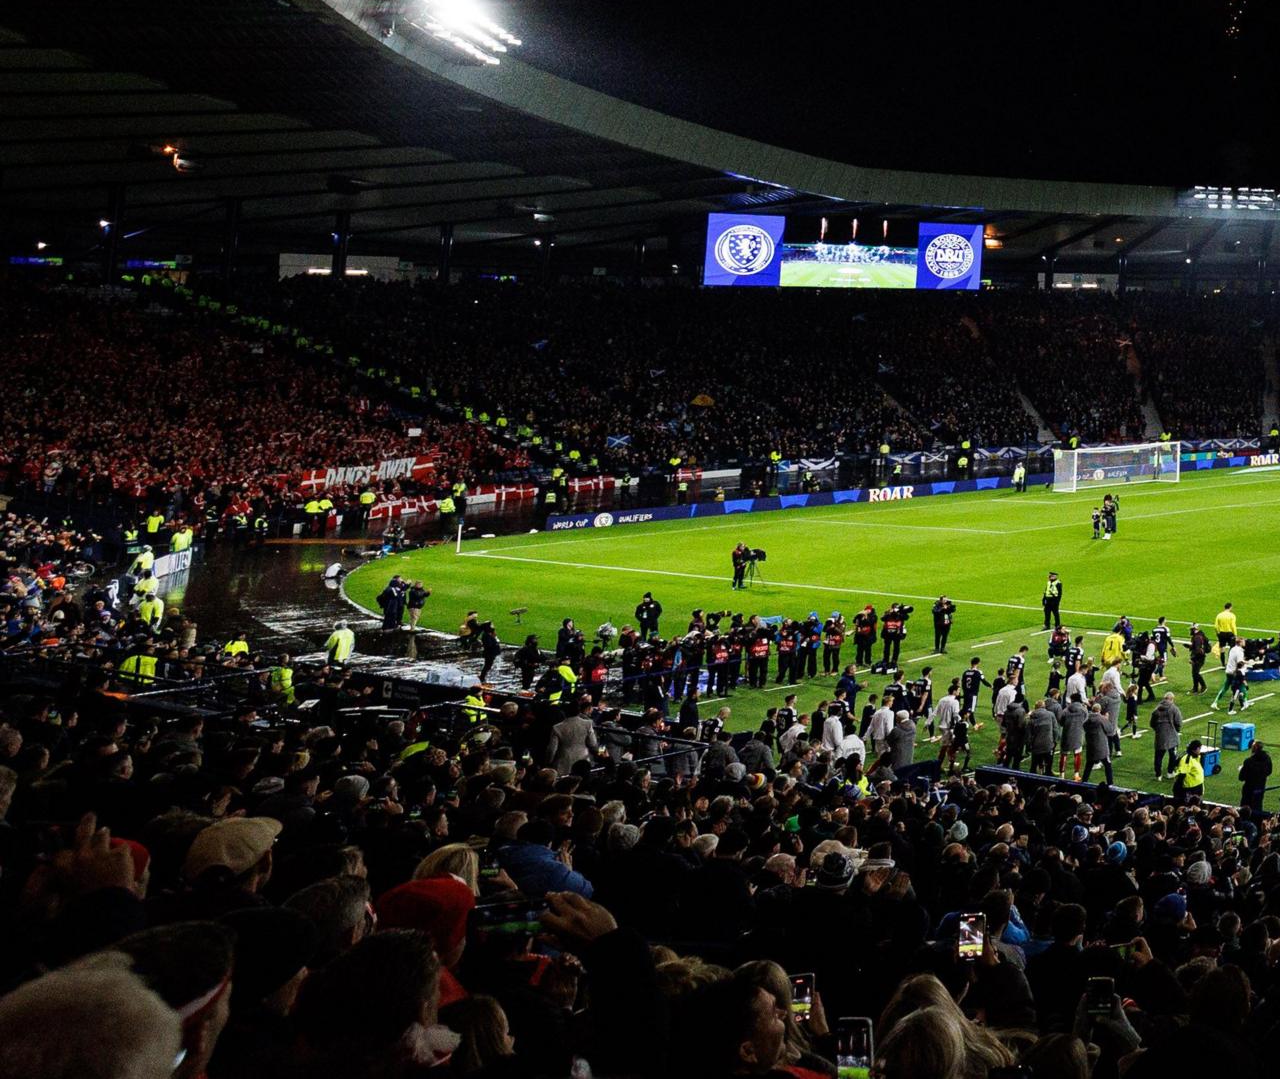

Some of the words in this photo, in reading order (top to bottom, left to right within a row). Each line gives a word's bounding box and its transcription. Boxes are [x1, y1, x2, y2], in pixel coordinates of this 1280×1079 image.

[935, 248, 964, 262] DBU
[1250, 454, 1279, 466] ROAR
[377, 457, 416, 480] AWAY
[868, 486, 914, 503] ROAR
[1155, 633, 1161, 643] 3
[1109, 640, 1113, 651] 1
